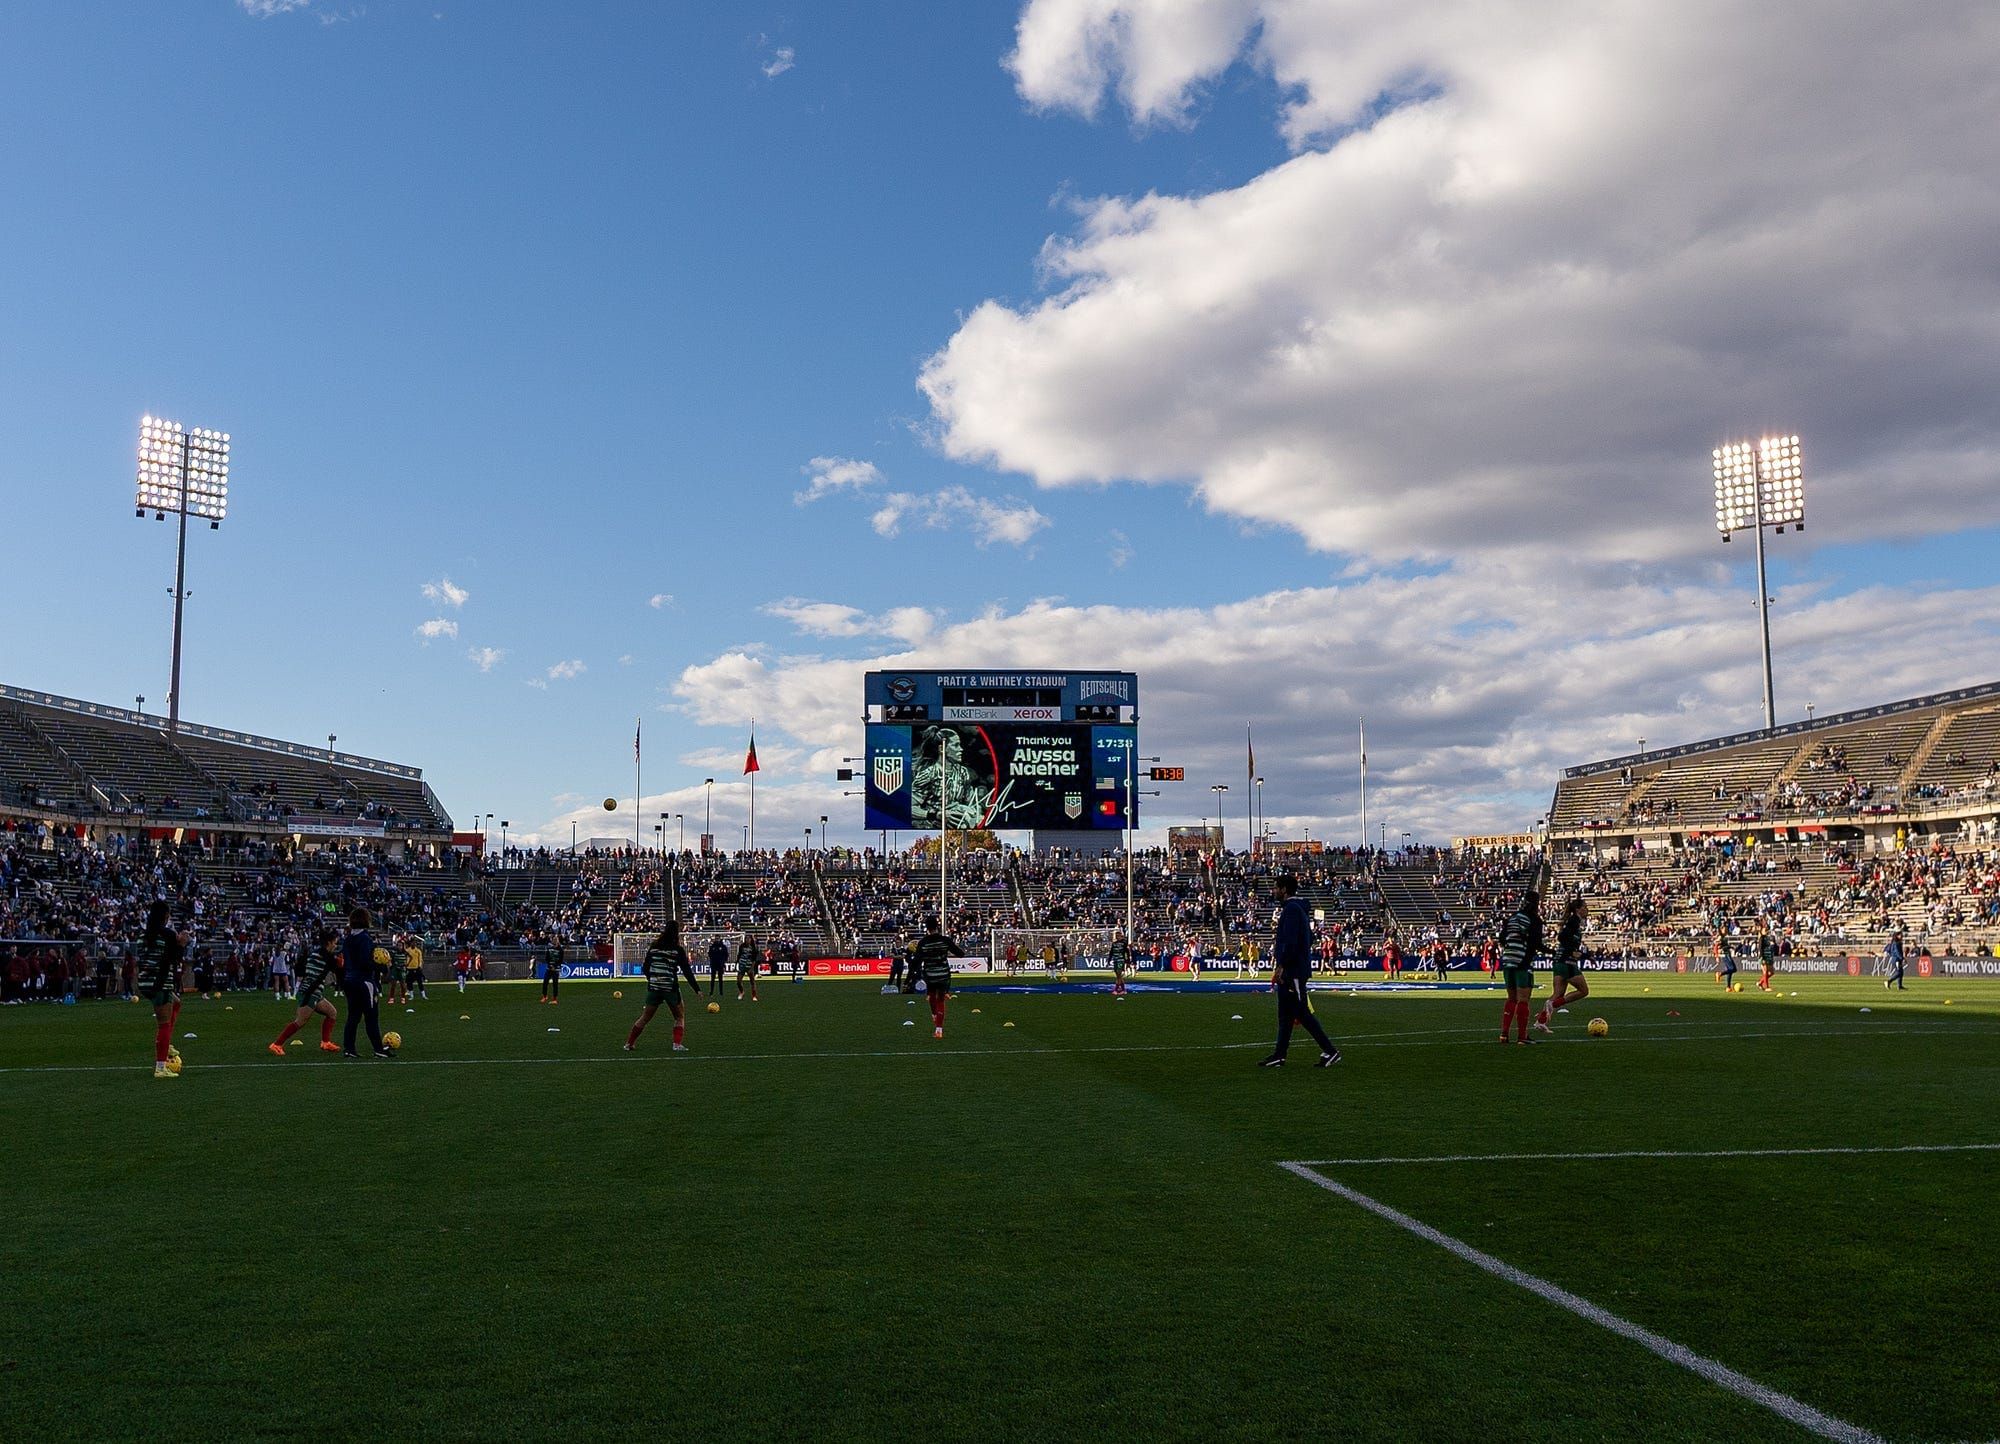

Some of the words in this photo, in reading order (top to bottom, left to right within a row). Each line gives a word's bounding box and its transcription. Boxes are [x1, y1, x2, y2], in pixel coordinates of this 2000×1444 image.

[937, 676, 967, 686] PRATT
[969, 676, 977, 686] &
[980, 676, 1022, 686] WHITNEY
[1025, 676, 1067, 687] STADIUM
[1013, 709, 1053, 719] xerox
[1016, 736, 1050, 745] Thank
[1051, 737, 1072, 746] you
[1097, 739, 1133, 748] 17:38
[1013, 748, 1076, 763] Alyssa
[876, 758, 901, 773] USA
[1009, 762, 1079, 776] Naeher
[1155, 768, 1183, 780] 17:38
[1035, 780, 1055, 791] #1
[1469, 836, 1507, 846] BEAR'S
[1511, 835, 1533, 844] BBQ
[838, 963, 870, 972] Henkel
[994, 959, 1008, 970] NIK
[1025, 959, 1046, 970] CCER
[1204, 958, 1240, 969] Than
[1629, 959, 1669, 970] Naeher
[1741, 959, 1761, 970] Than
[1781, 959, 1807, 972] Alyssa
[1808, 960, 1838, 971] Naeher
[1943, 960, 1978, 973] Thank
[1980, 961, 2000, 973] You
[570, 966, 610, 977] Allstate
